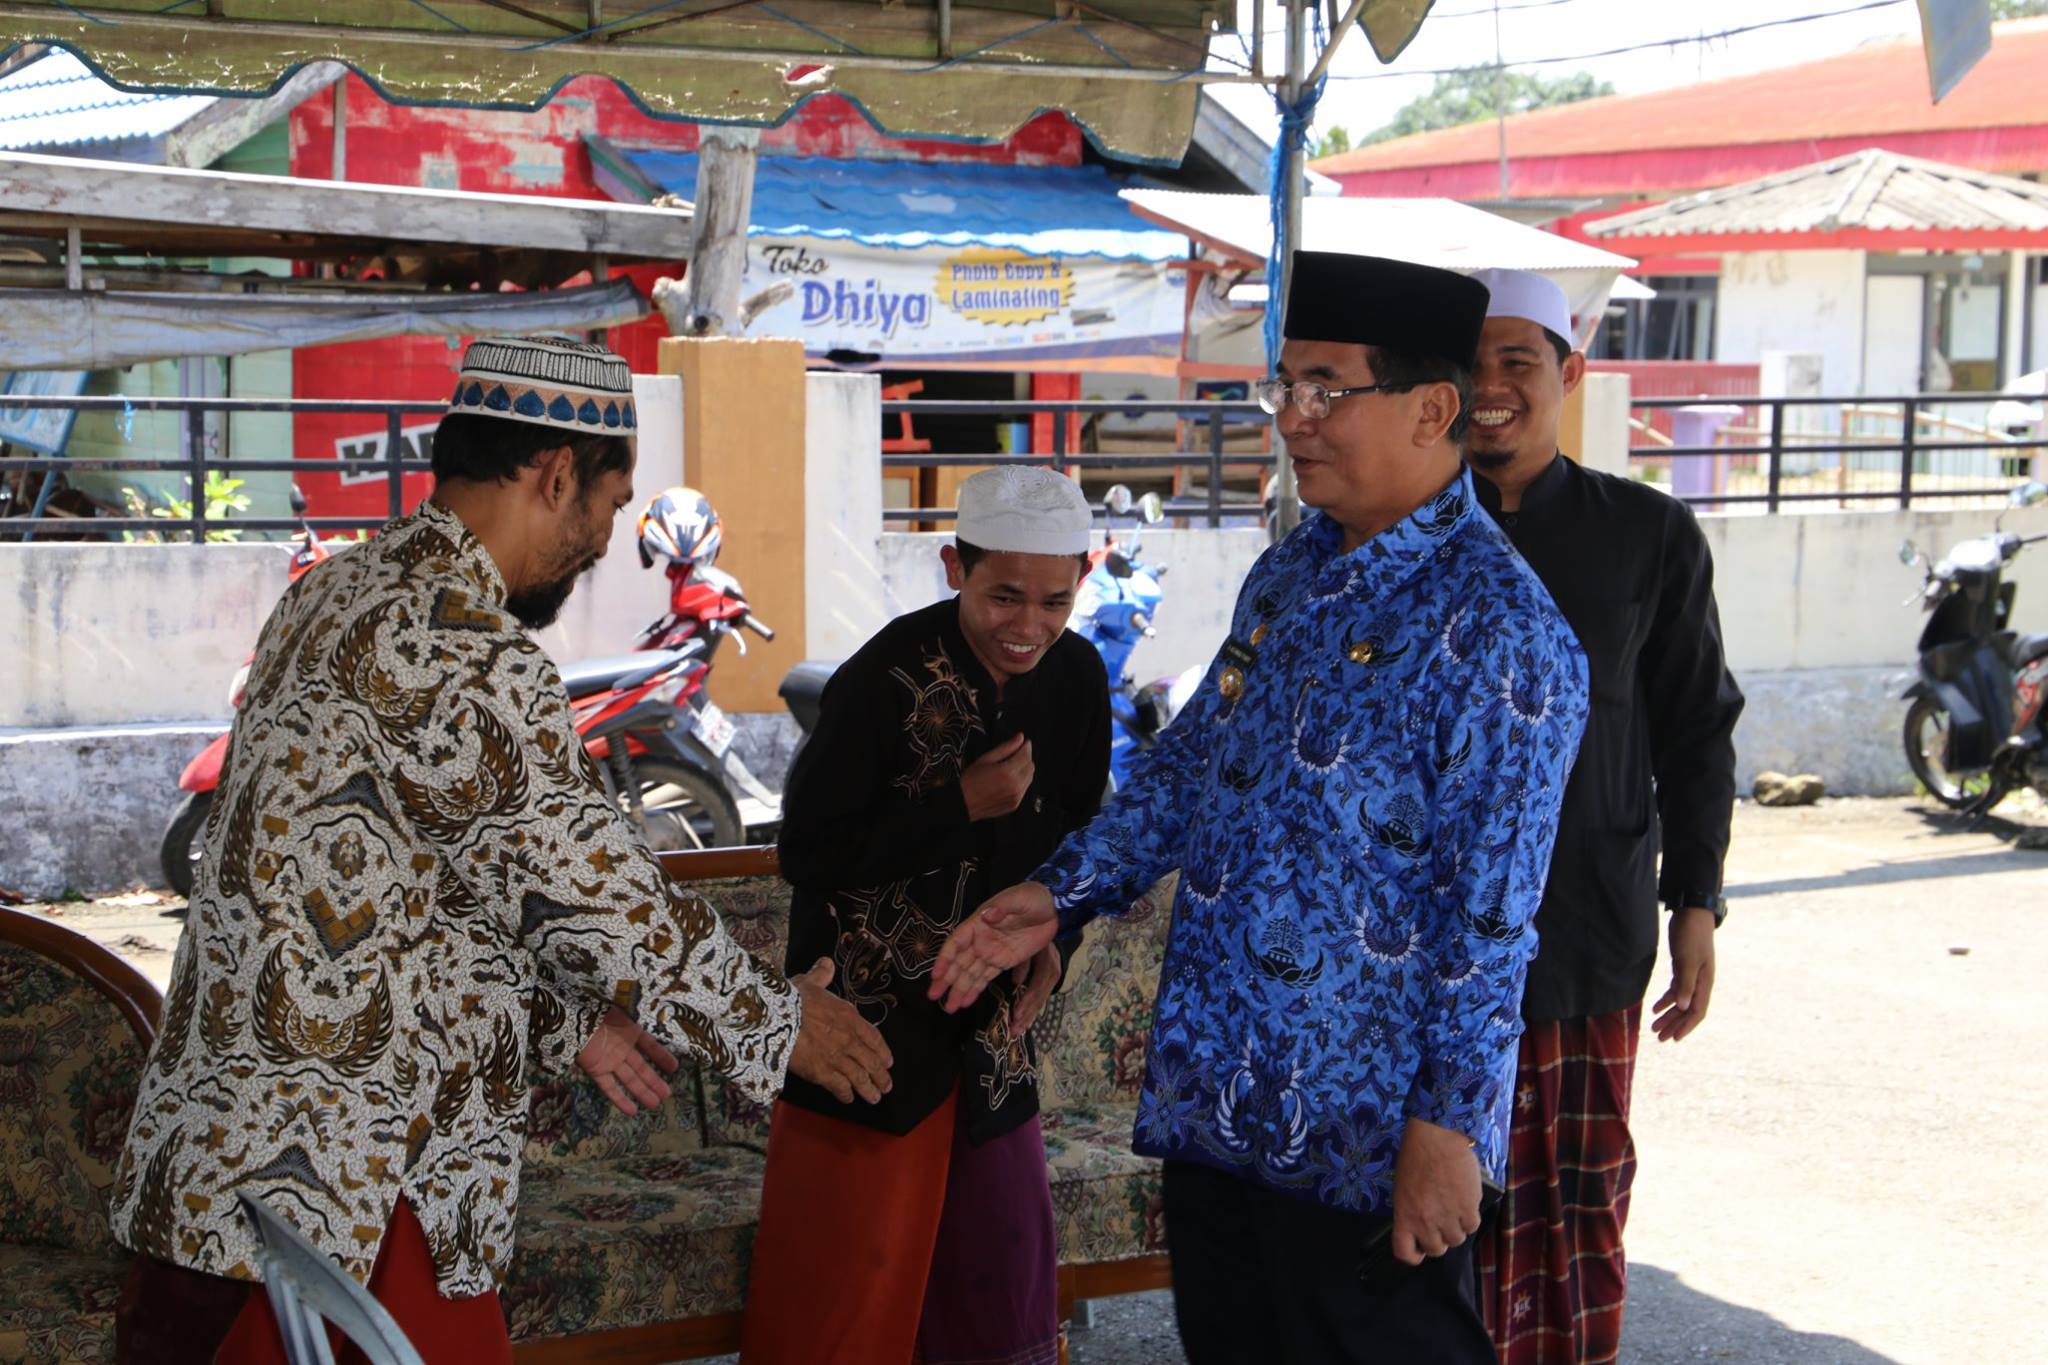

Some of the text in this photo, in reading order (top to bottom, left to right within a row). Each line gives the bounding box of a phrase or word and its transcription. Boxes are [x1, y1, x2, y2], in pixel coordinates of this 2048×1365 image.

[762, 245, 829, 275] Toko
[952, 263, 998, 281] Photo
[1005, 262, 1044, 280] Copy
[801, 278, 930, 337] Dhiya
[952, 288, 1060, 312] Laminating
